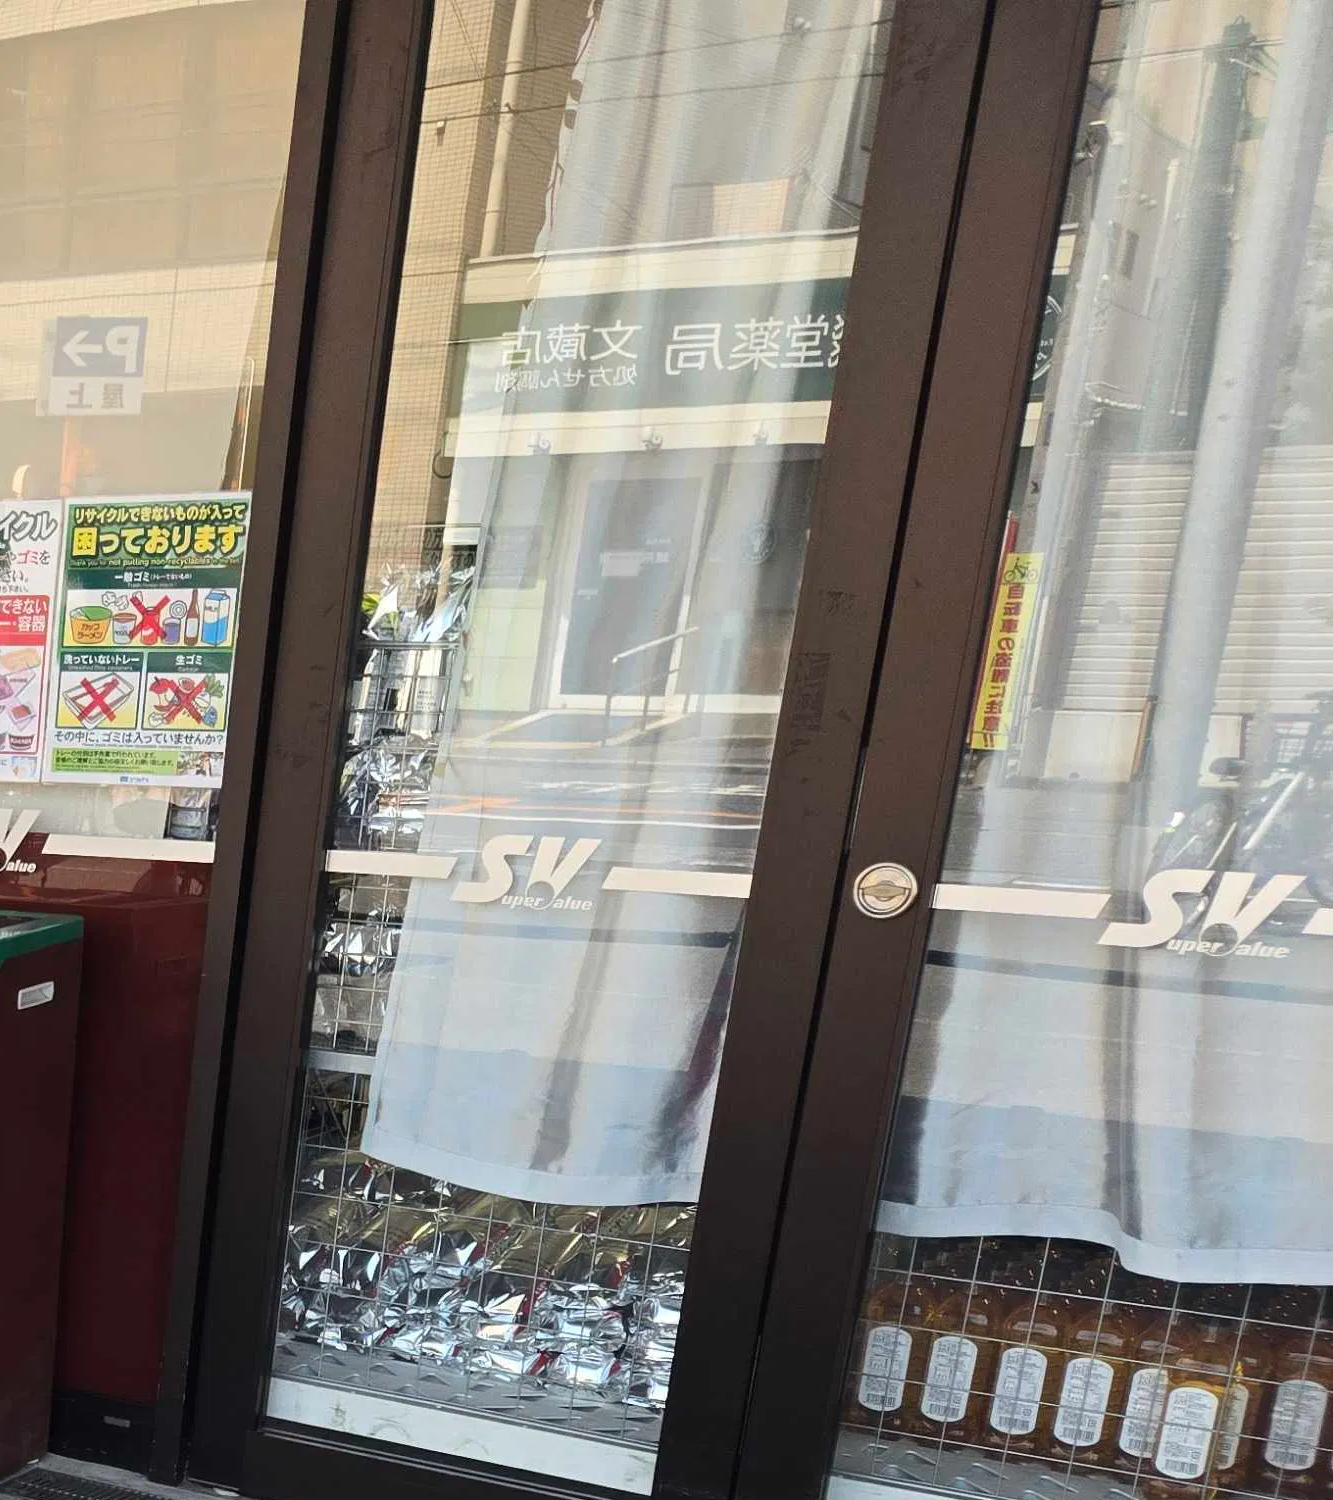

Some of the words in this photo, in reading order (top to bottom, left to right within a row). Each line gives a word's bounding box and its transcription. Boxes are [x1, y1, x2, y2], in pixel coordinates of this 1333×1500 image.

[75, 504, 246, 524] リサイクルできないものが入って
[71, 524, 245, 557] 困っております
[123, 558, 149, 568] putting
[114, 571, 150, 582] 一般ゴミ
[64, 654, 140, 665] 洗っていないトレー
[175, 654, 203, 665] 生ゴミ
[55, 730, 223, 746] その中に、ゴミは入っていませんか?
